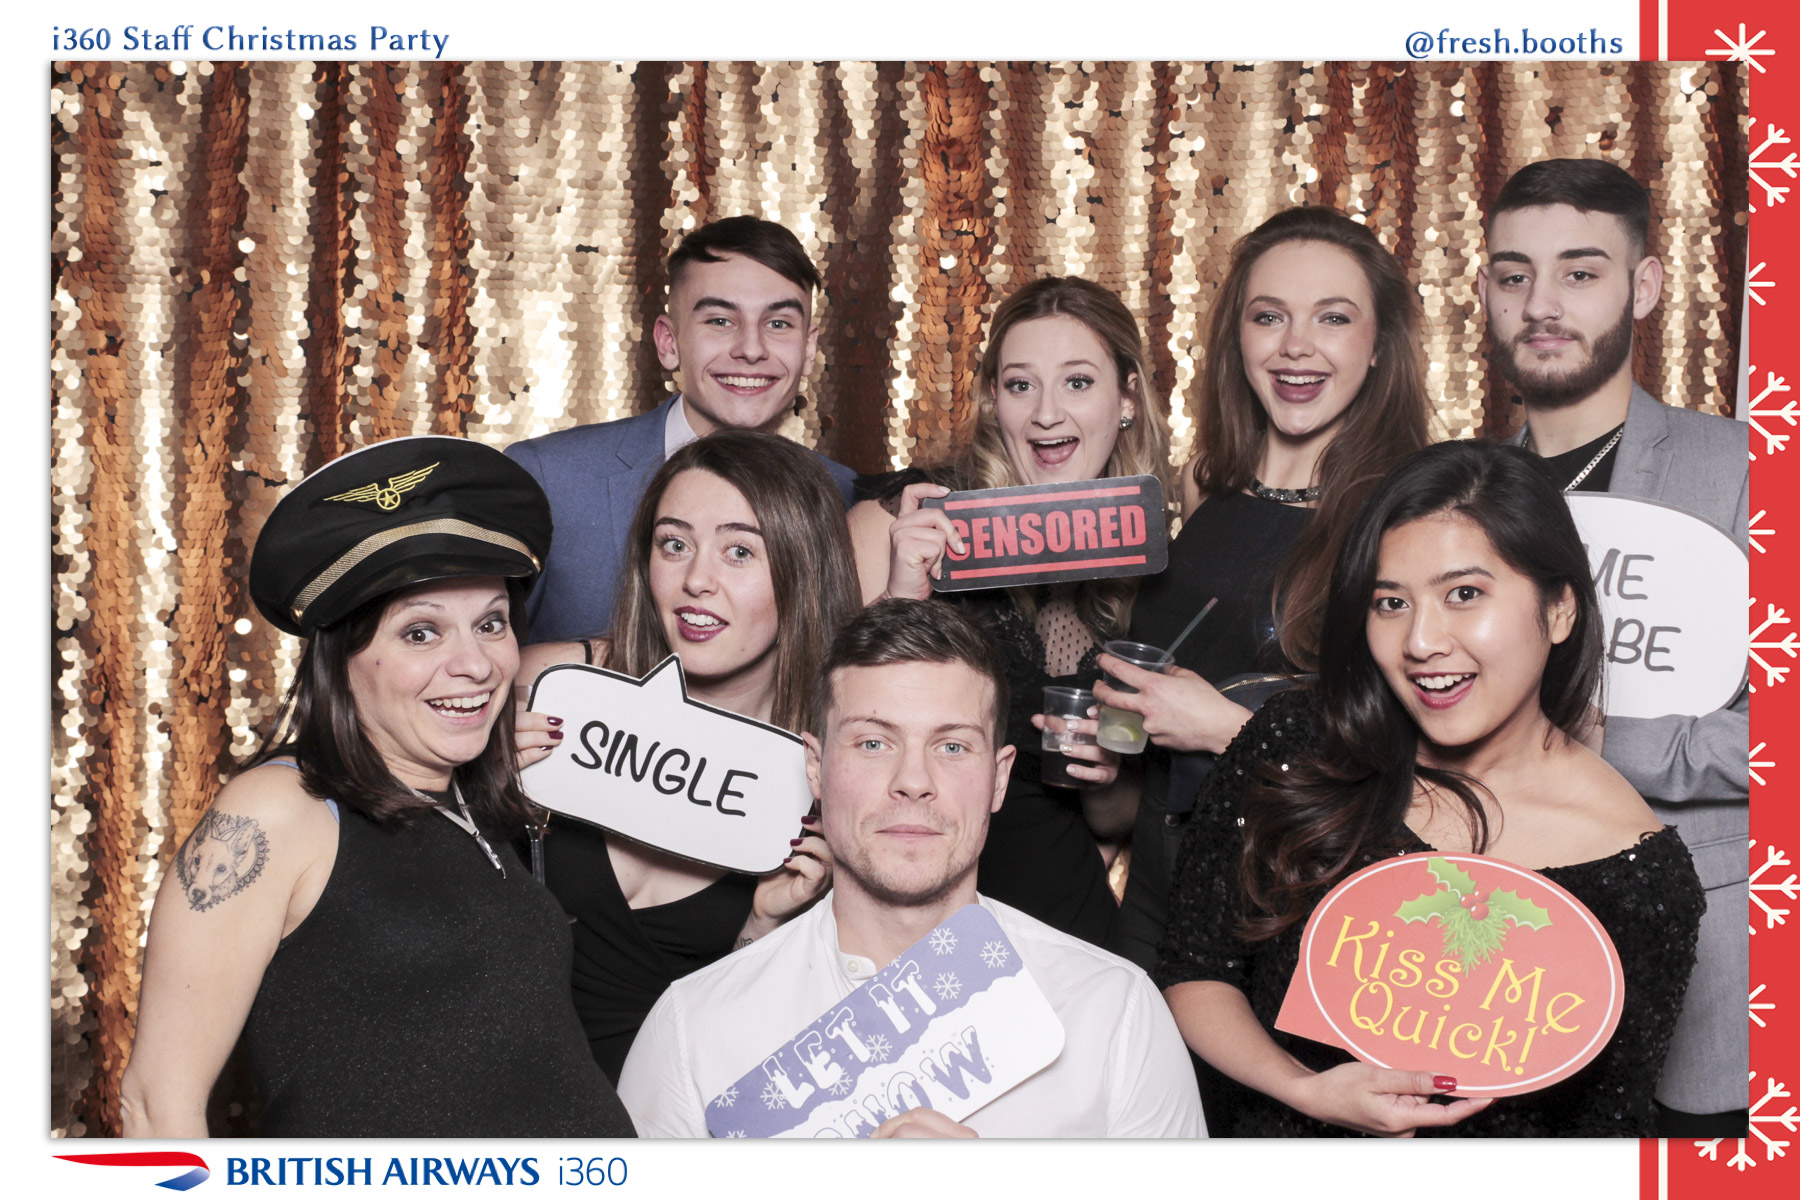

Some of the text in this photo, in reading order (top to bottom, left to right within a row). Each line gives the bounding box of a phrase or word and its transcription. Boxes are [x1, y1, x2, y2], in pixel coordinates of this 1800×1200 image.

[946, 505, 1147, 561] CENSORED
[1606, 617, 1682, 672] BE
[571, 720, 758, 817] SINGLE
[1326, 915, 1586, 1034] Kiss Me
[762, 960, 937, 1109] LET IT
[1350, 981, 1538, 1075] Quick!
